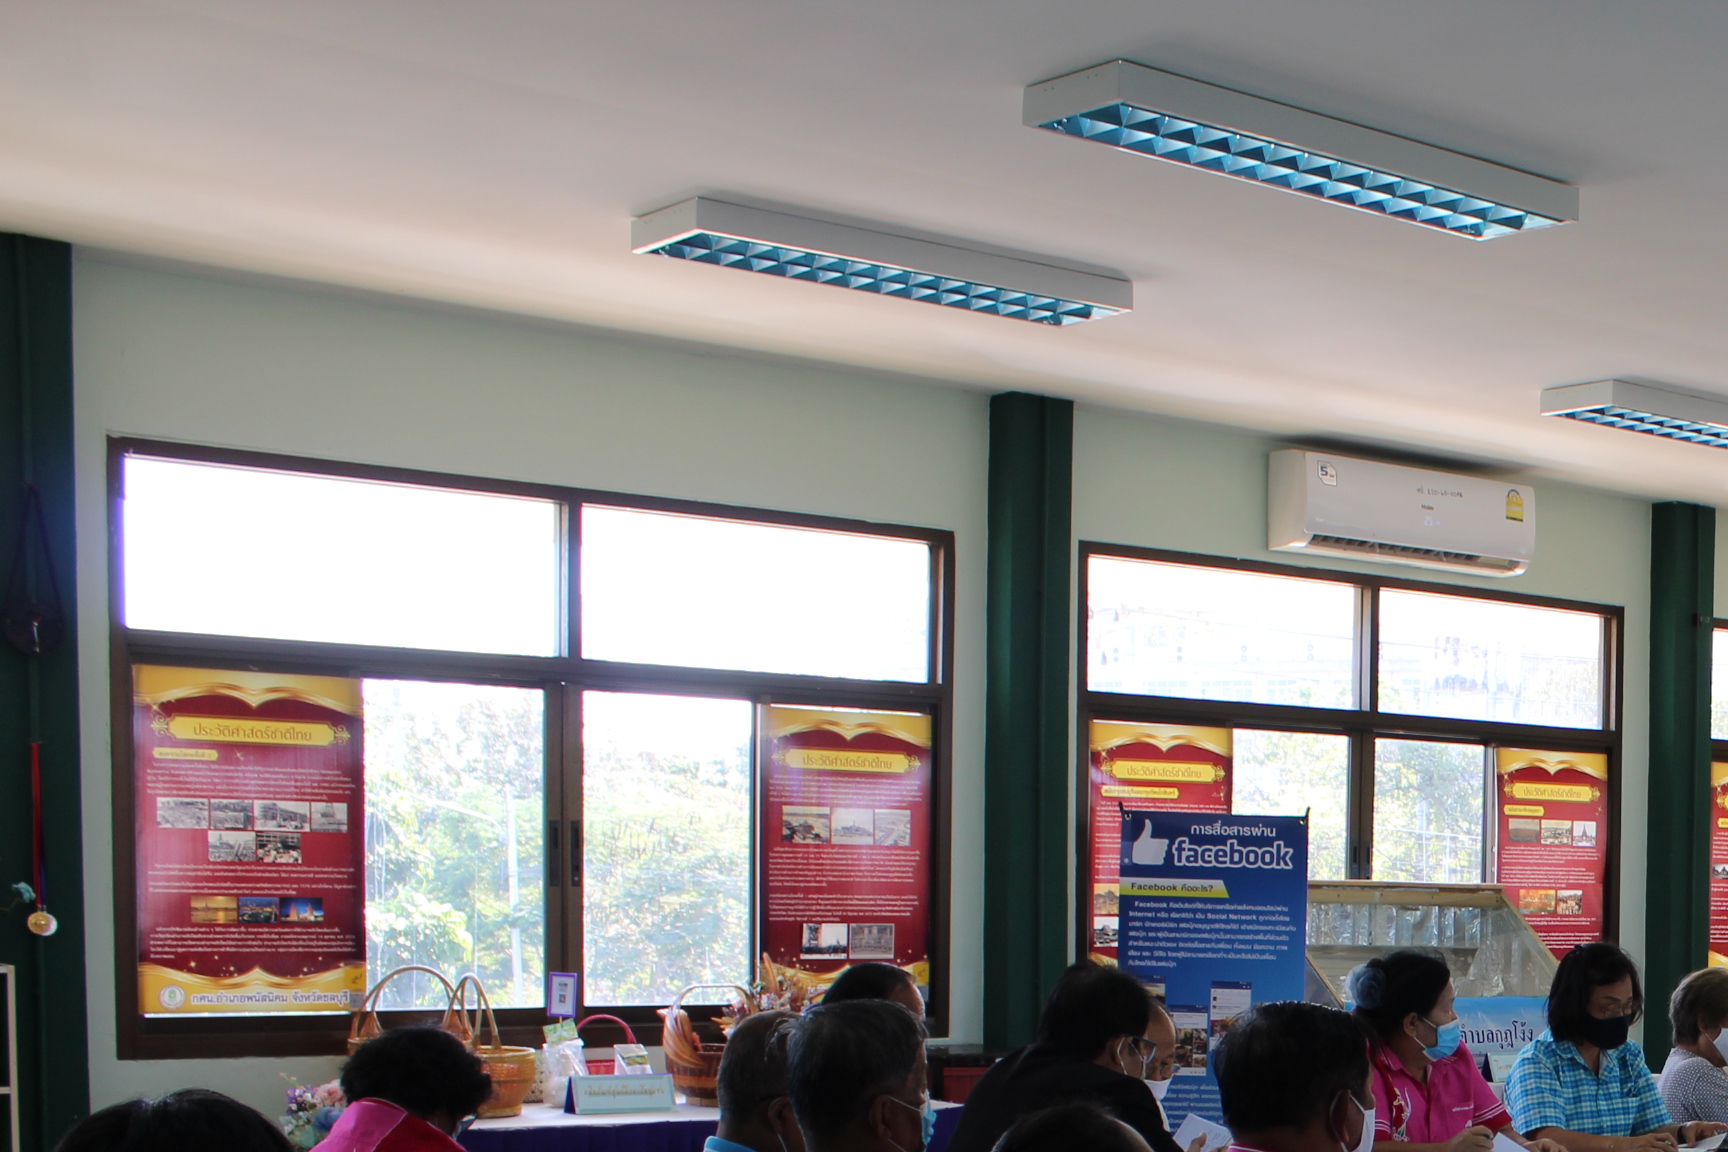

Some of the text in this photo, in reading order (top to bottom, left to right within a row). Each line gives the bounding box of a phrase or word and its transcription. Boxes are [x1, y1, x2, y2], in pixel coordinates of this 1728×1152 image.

[193, 723, 312, 742] ประวัติศาสตร์ชาติไทย
[803, 753, 892, 769] ประวัติศาสตร์ชาติไทย
[1127, 766, 1202, 779] ประวัติศาสตร์ชาติไทย
[1523, 786, 1581, 799] ประวัติศาสตร์ชาติไทย
[1191, 820, 1276, 837] การสื่อสารผ่าน
[1172, 837, 1293, 869] facebook
[1131, 882, 1213, 893] Facebook คืออะไร?
[1229, 913, 1257, 921] Network
[191, 990, 350, 1008] กศน.อำเภอพนัสนิคม จังหวัดชลบุรี
